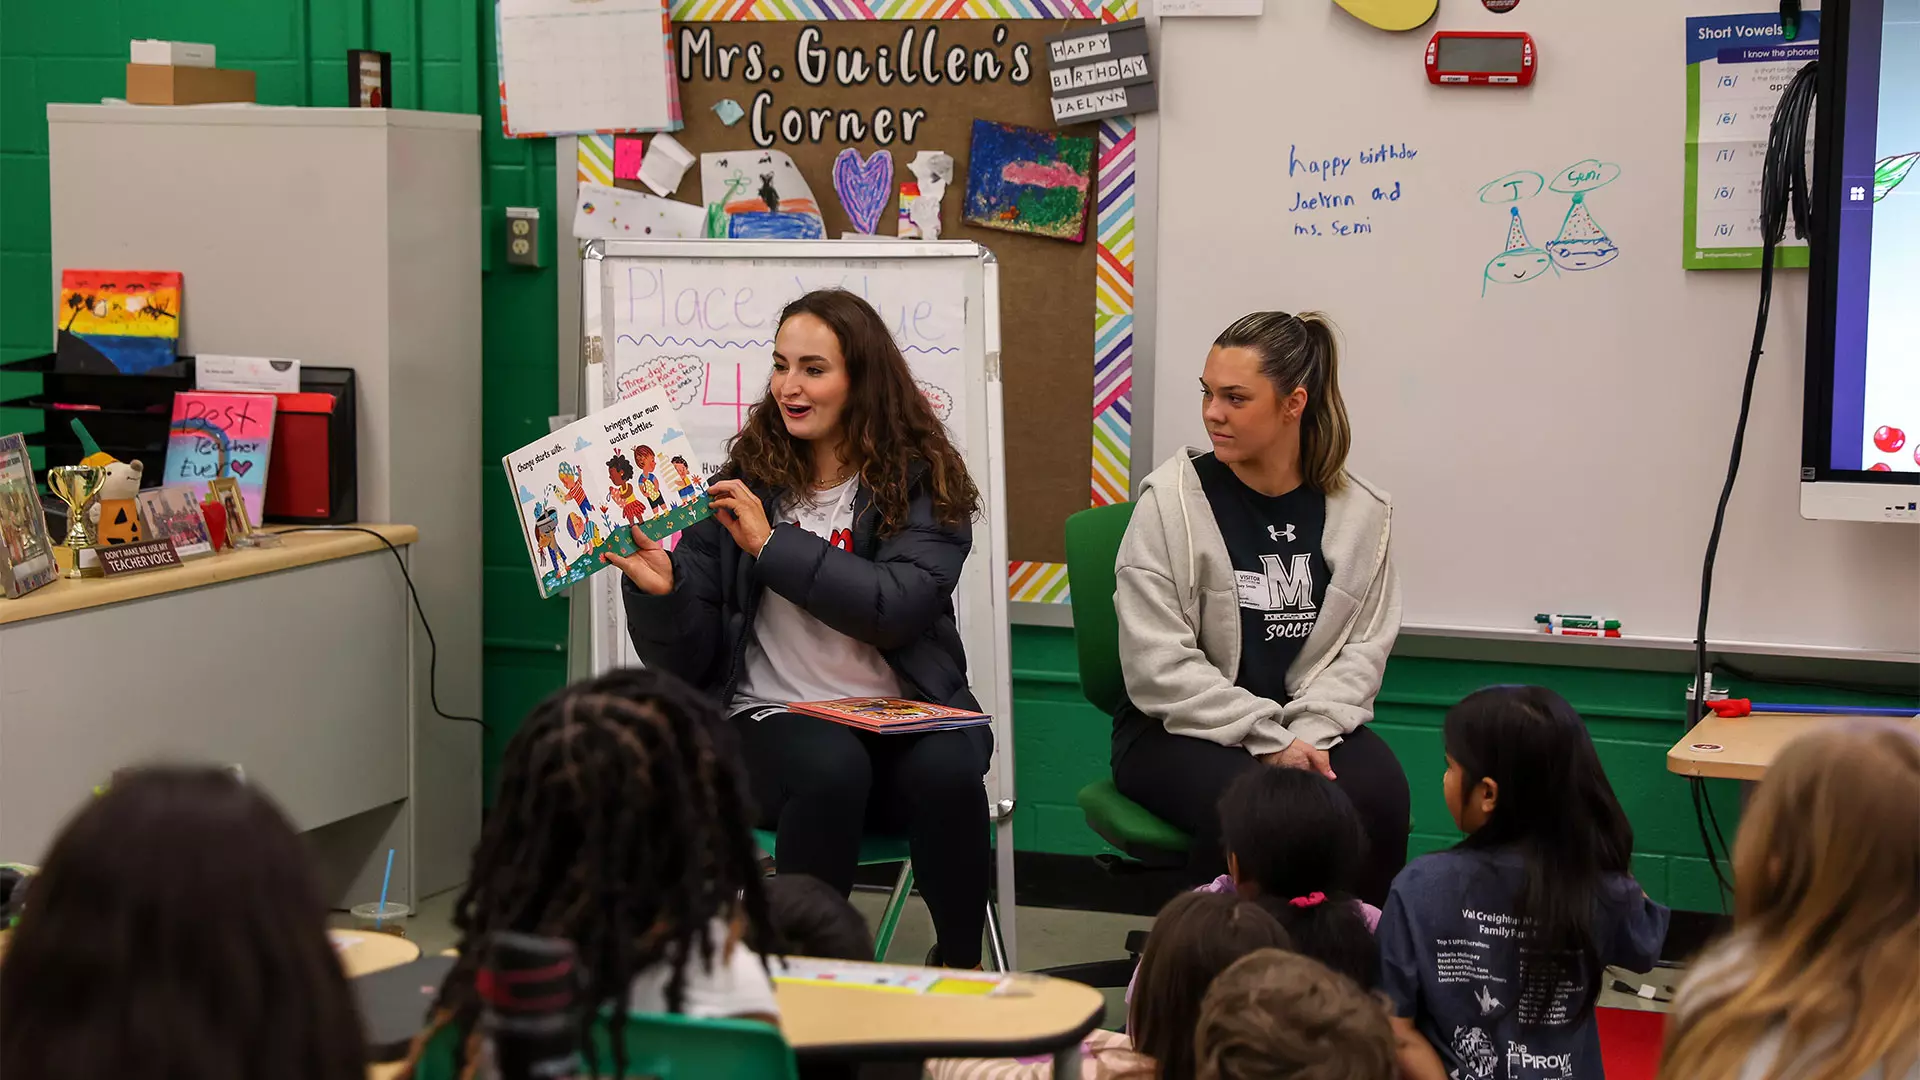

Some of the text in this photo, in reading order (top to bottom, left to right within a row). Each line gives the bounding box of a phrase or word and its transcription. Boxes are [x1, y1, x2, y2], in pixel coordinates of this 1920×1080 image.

[1698, 24, 1783, 40] Short Vowels
[678, 23, 1032, 86] Mrs. Guillen's
[1053, 38, 1109, 58] HAPPY
[1748, 49, 1770, 58] know
[1771, 49, 1785, 57] the
[1053, 60, 1145, 87] BIRTHDAY
[750, 90, 925, 148] Corner
[1289, 143, 1418, 181] happy birthday
[1371, 181, 1401, 201] and
[1331, 216, 1372, 237] Semi
[628, 266, 766, 331] Place
[622, 381, 657, 400] numbers
[656, 367, 678, 383] have
[183, 400, 257, 435] Best
[604, 404, 660, 432] bringing our own
[609, 421, 655, 445] water bottles.
[194, 435, 260, 455] Teacher
[180, 457, 230, 479] Ever
[517, 459, 535, 473] Change
[535, 450, 550, 463] starts
[104, 543, 169, 560] DON'T MAKE ME USE MY
[109, 551, 175, 572] TEACHER VOICE
[1240, 574, 1260, 582] VISITOR
[1259, 552, 1317, 611] M
[1462, 908, 1475, 920] Val
[1479, 924, 1511, 939] Family
